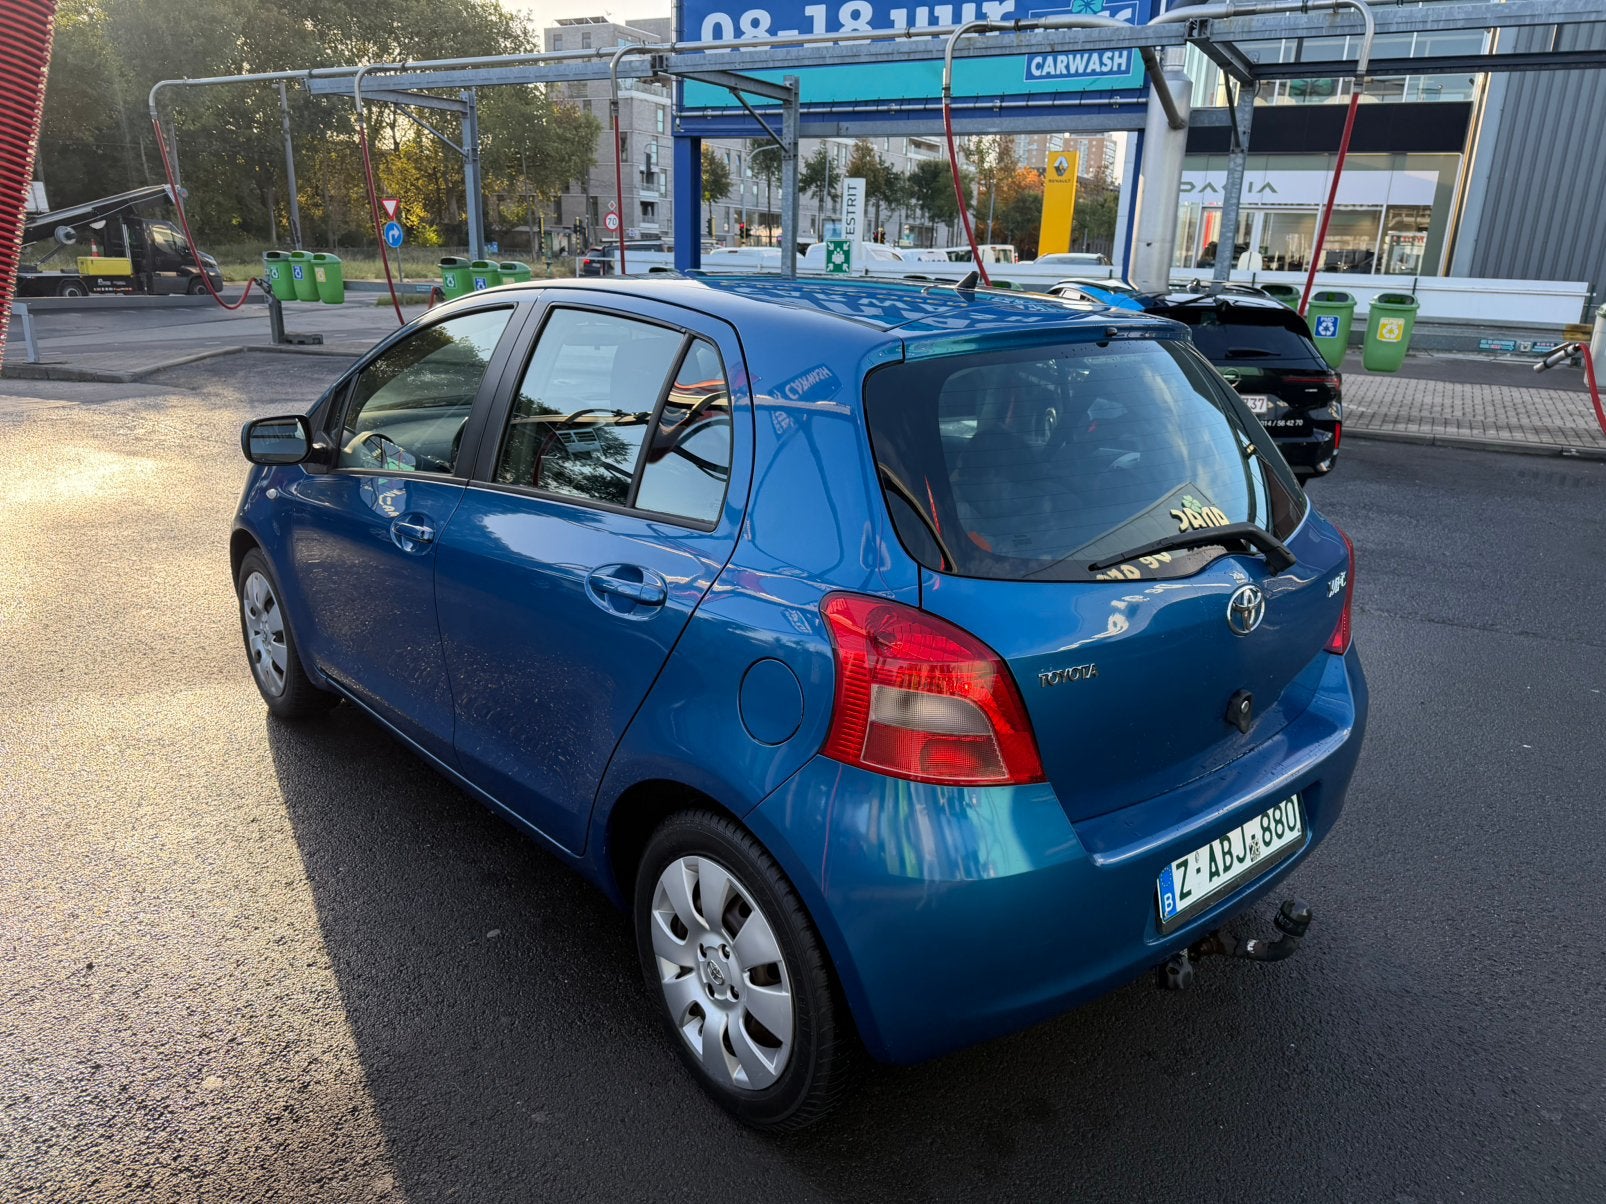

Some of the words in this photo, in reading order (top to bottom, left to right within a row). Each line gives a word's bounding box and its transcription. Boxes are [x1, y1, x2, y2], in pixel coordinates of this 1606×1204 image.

[700, 0, 873, 54] 08-18
[889, 0, 1015, 42] uur
[1030, 50, 1128, 77] CARWASH
[1180, 181, 1279, 194] DAIA
[607, 217, 617, 226] 70
[844, 183, 857, 241] ESTRIT
[1295, 419, 1304, 427] 70
[1038, 663, 1099, 688] TOYOTA
[1164, 892, 1174, 914] B
